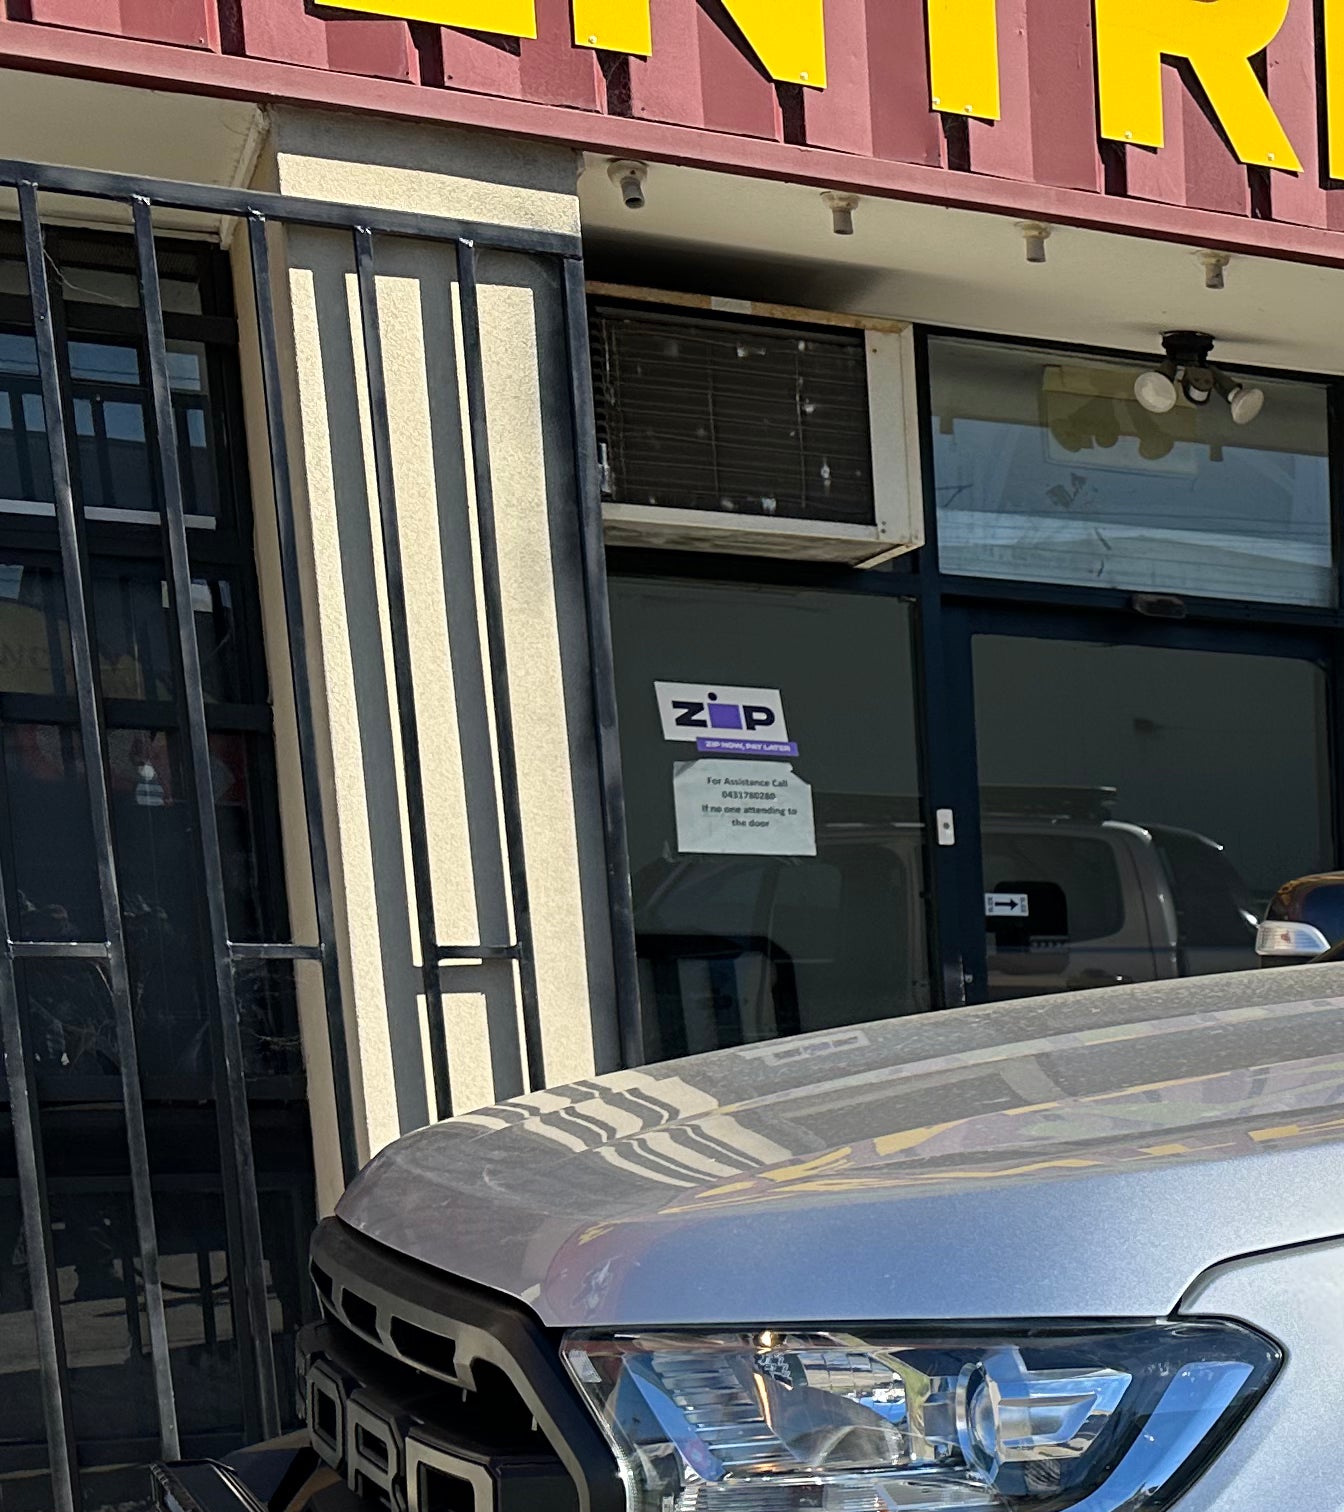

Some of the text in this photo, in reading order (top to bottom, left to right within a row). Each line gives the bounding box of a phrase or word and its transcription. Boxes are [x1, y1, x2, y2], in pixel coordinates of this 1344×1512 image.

[707, 777, 788, 787] For Assistance Call
[744, 806, 786, 817] attending
[731, 818, 769, 827] the door
